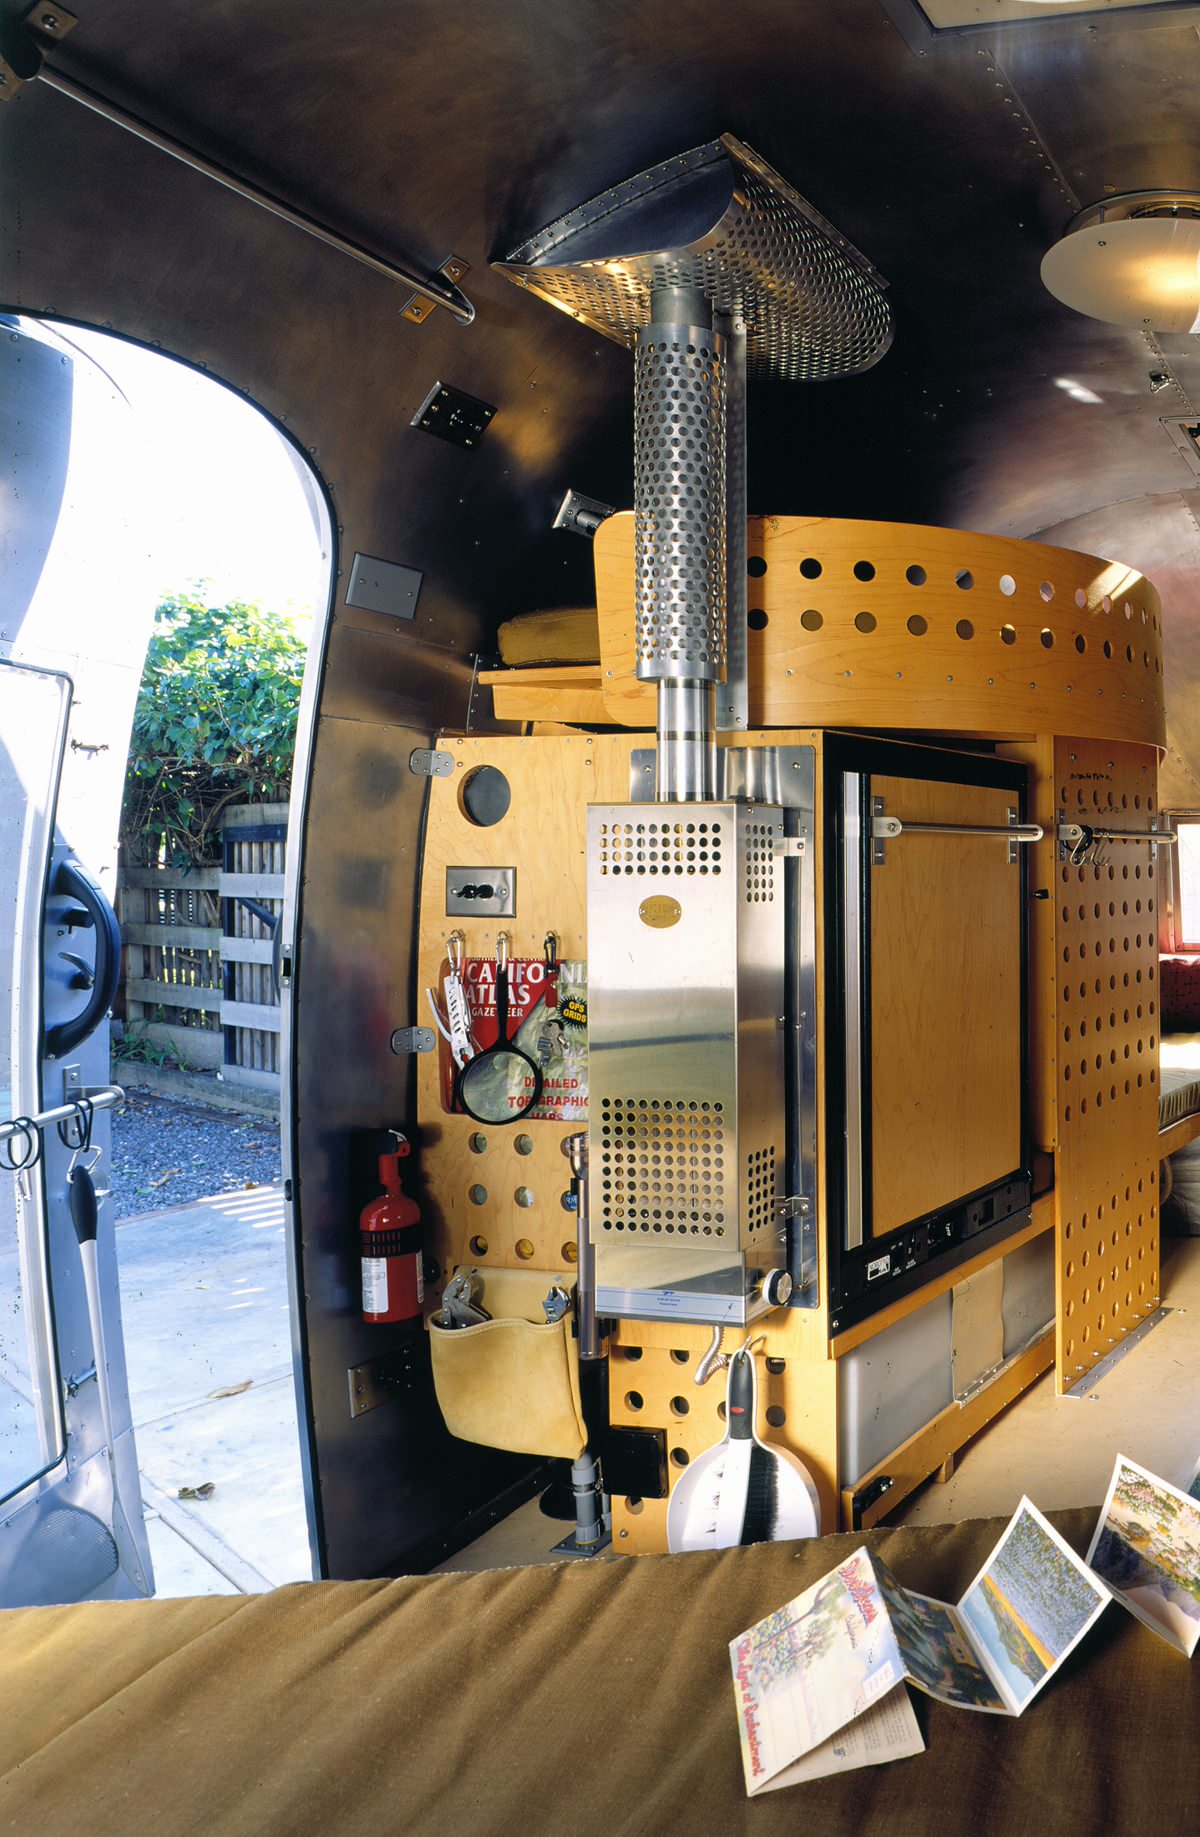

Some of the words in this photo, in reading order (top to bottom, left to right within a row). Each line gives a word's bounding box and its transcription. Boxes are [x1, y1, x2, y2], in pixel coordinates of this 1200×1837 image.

[466, 962, 588, 984] CAIFONI
[471, 1007, 523, 1017] GAZEEER
[568, 1001, 585, 1012] GPS
[563, 1009, 587, 1023] GRIDS
[524, 1077, 578, 1089] DEAILED
[507, 1096, 589, 1108] TOPGRAPHIC
[743, 1704, 766, 1777] Enchantment
